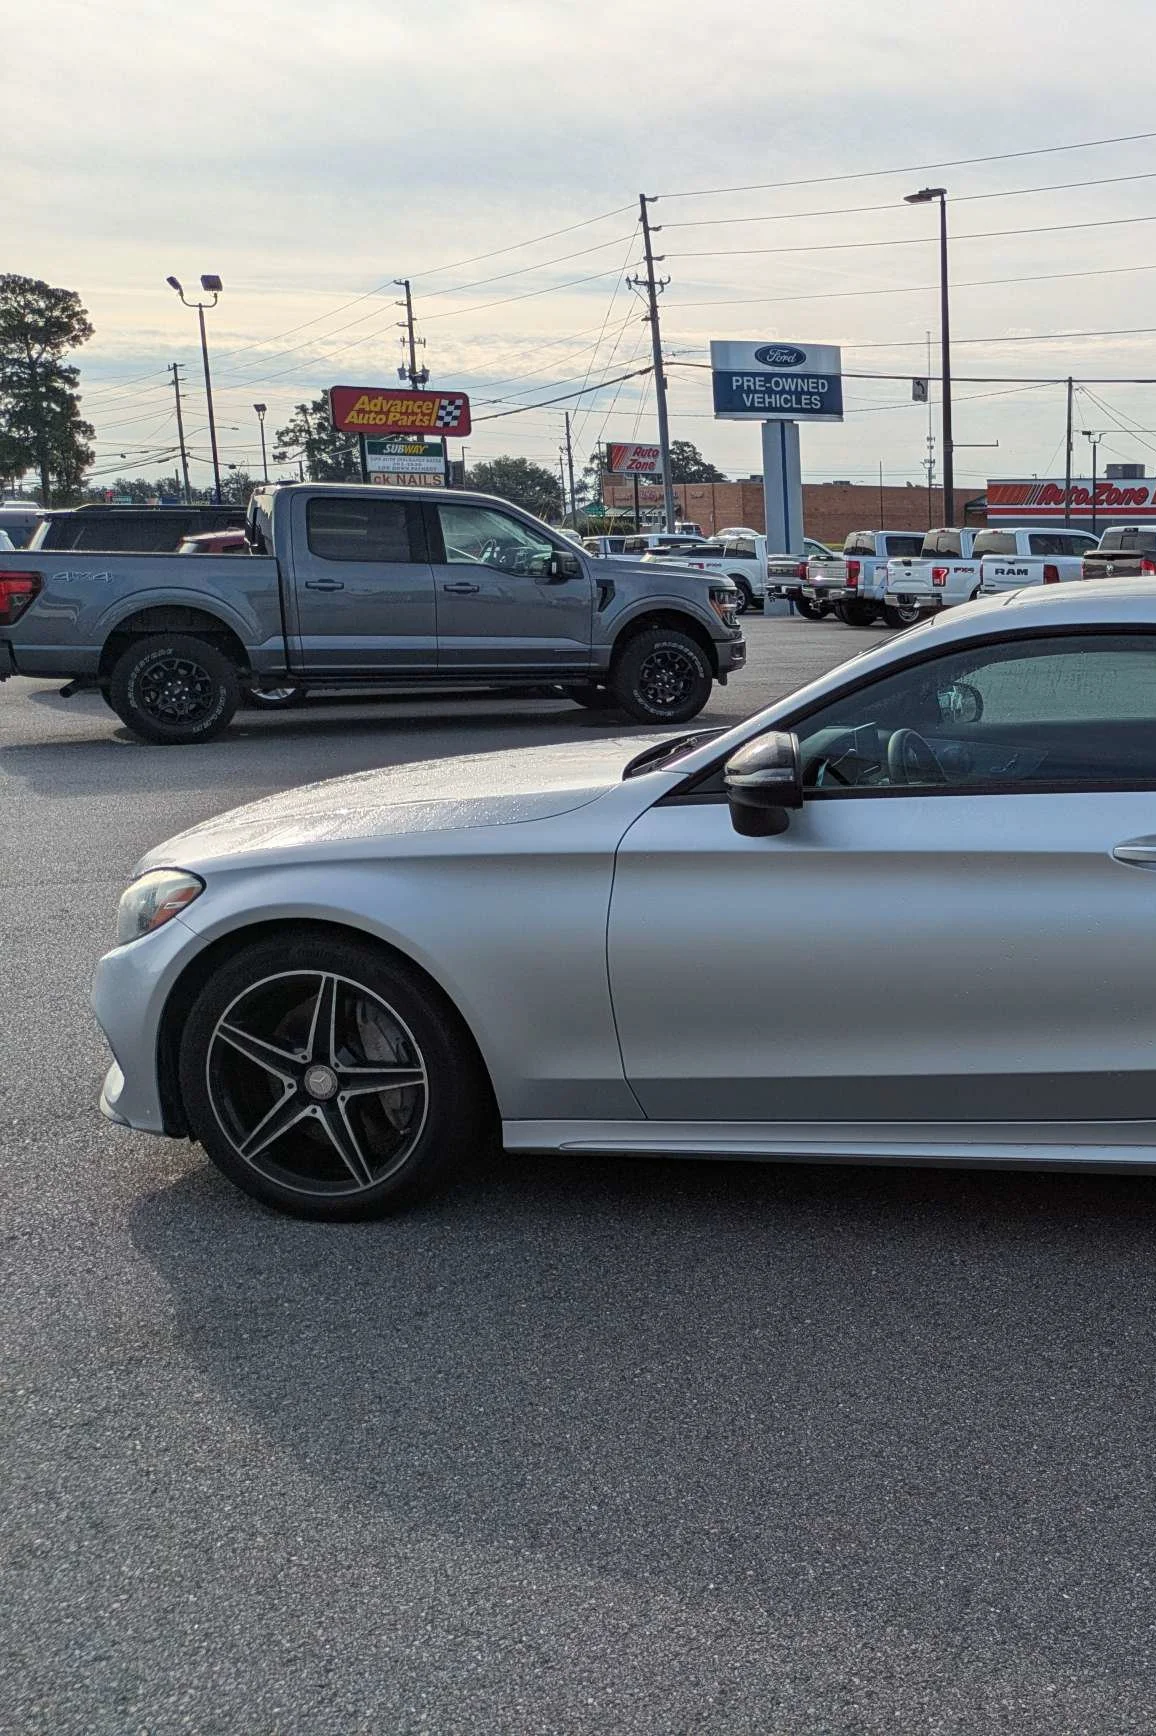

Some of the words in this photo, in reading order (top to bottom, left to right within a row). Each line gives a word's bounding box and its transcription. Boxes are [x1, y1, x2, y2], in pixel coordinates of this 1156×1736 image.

[766, 348, 798, 363] Ford
[732, 376, 829, 393] PRE-OWNED
[352, 395, 433, 413] Advance
[742, 393, 821, 409] VEHICLES
[343, 410, 386, 425] Auto
[386, 412, 431, 427] Parts
[383, 443, 426, 455] SUBWAY
[632, 446, 660, 458] Auto
[626, 458, 656, 470] Zone
[396, 474, 442, 486] NAILS
[1036, 483, 1150, 506] AutoZone
[994, 568, 1029, 576] RAM
